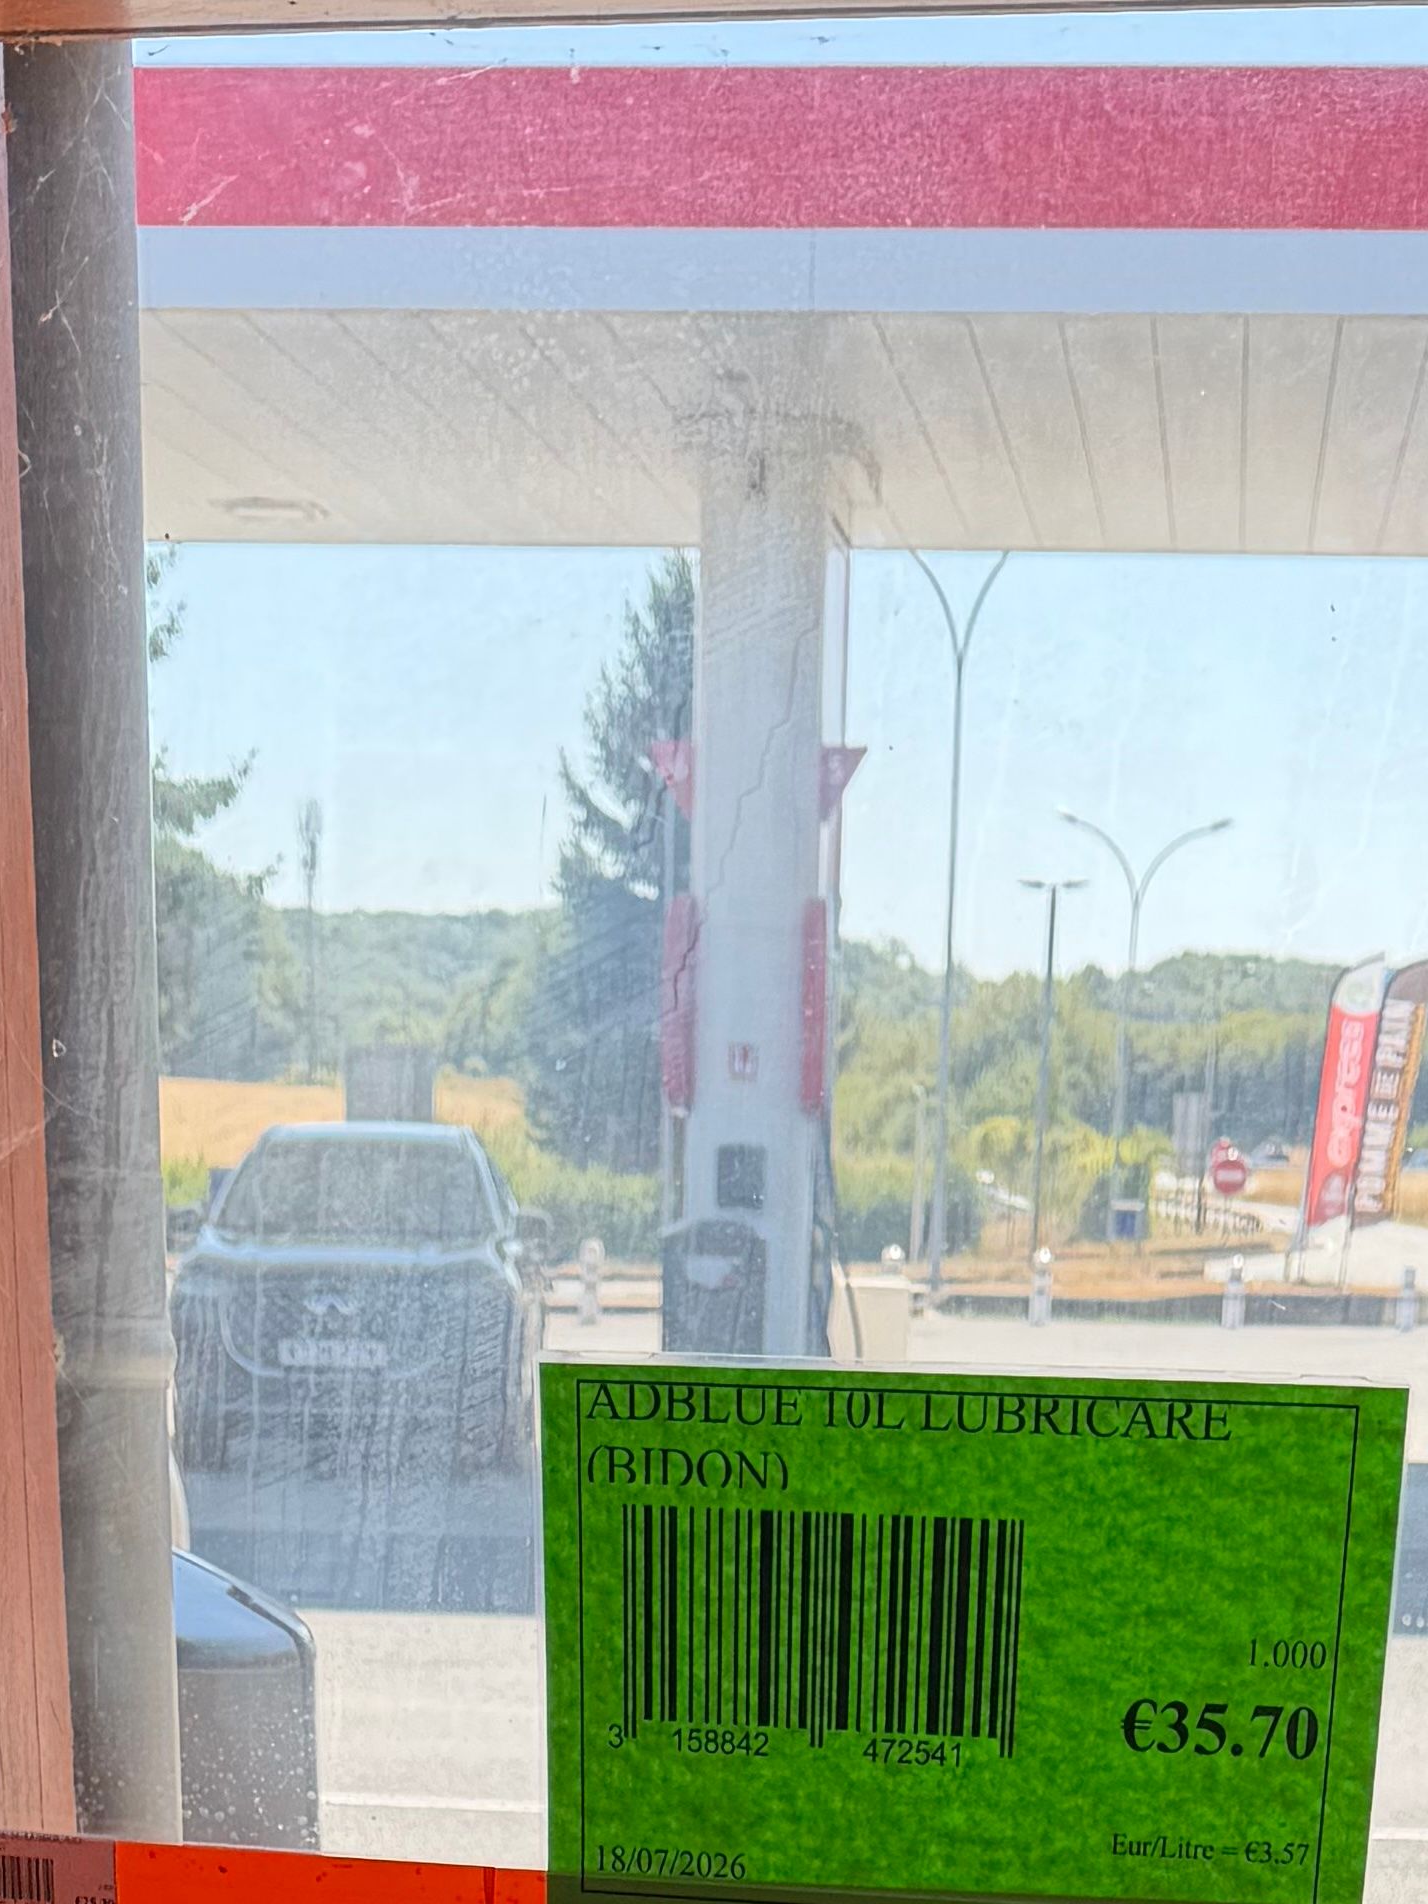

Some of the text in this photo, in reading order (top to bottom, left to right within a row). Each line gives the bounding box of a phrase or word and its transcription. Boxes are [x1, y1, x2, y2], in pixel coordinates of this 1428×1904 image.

[1326, 1017, 1365, 1169] express
[587, 1383, 1233, 1443] ADBLUE 10L LUBRICARE
[586, 1443, 790, 1492] (BIDON)
[1247, 1638, 1328, 1670] 1.000
[607, 1722, 964, 1767] 3 158842 472541
[1119, 1697, 1320, 1763] €35.70
[596, 1844, 748, 1882] 18/07/2026
[1110, 1831, 1311, 1867] Eur/Litre €3.57
